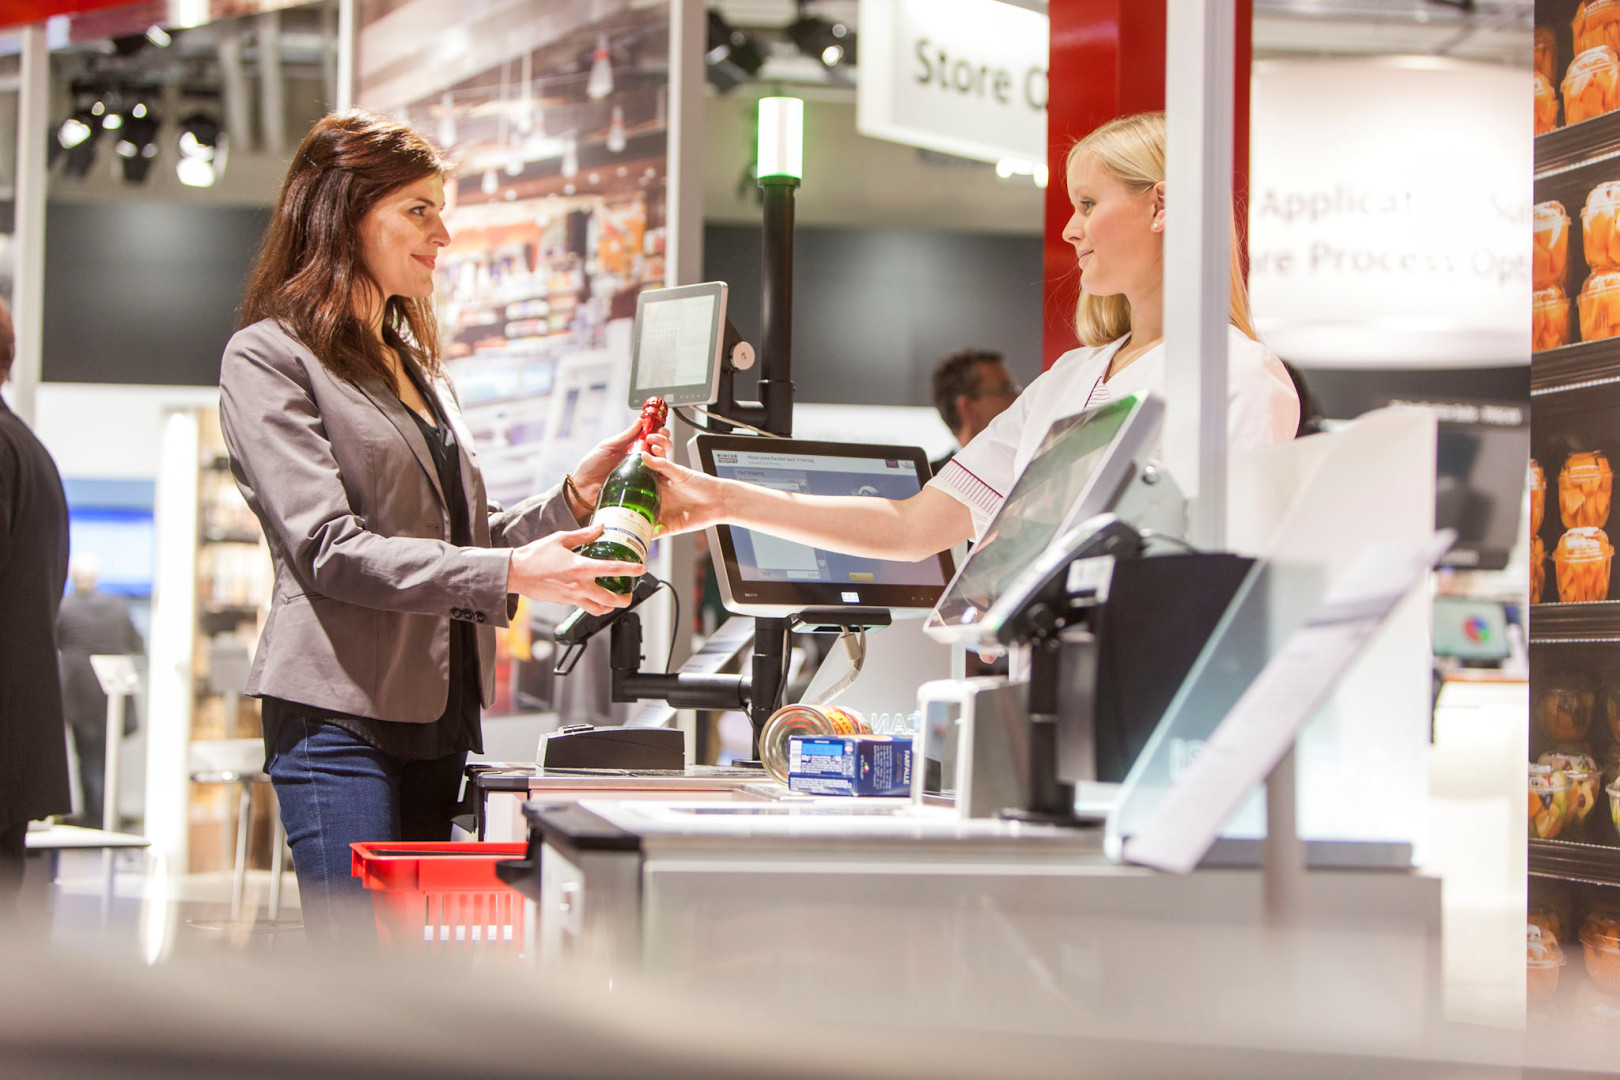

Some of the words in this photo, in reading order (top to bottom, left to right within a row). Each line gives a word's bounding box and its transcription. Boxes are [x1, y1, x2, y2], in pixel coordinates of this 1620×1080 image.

[914, 38, 1011, 104] Store
[1251, 249, 1295, 277] re
[1309, 242, 1456, 277] Process
[903, 749, 911, 785] FARFALLE
